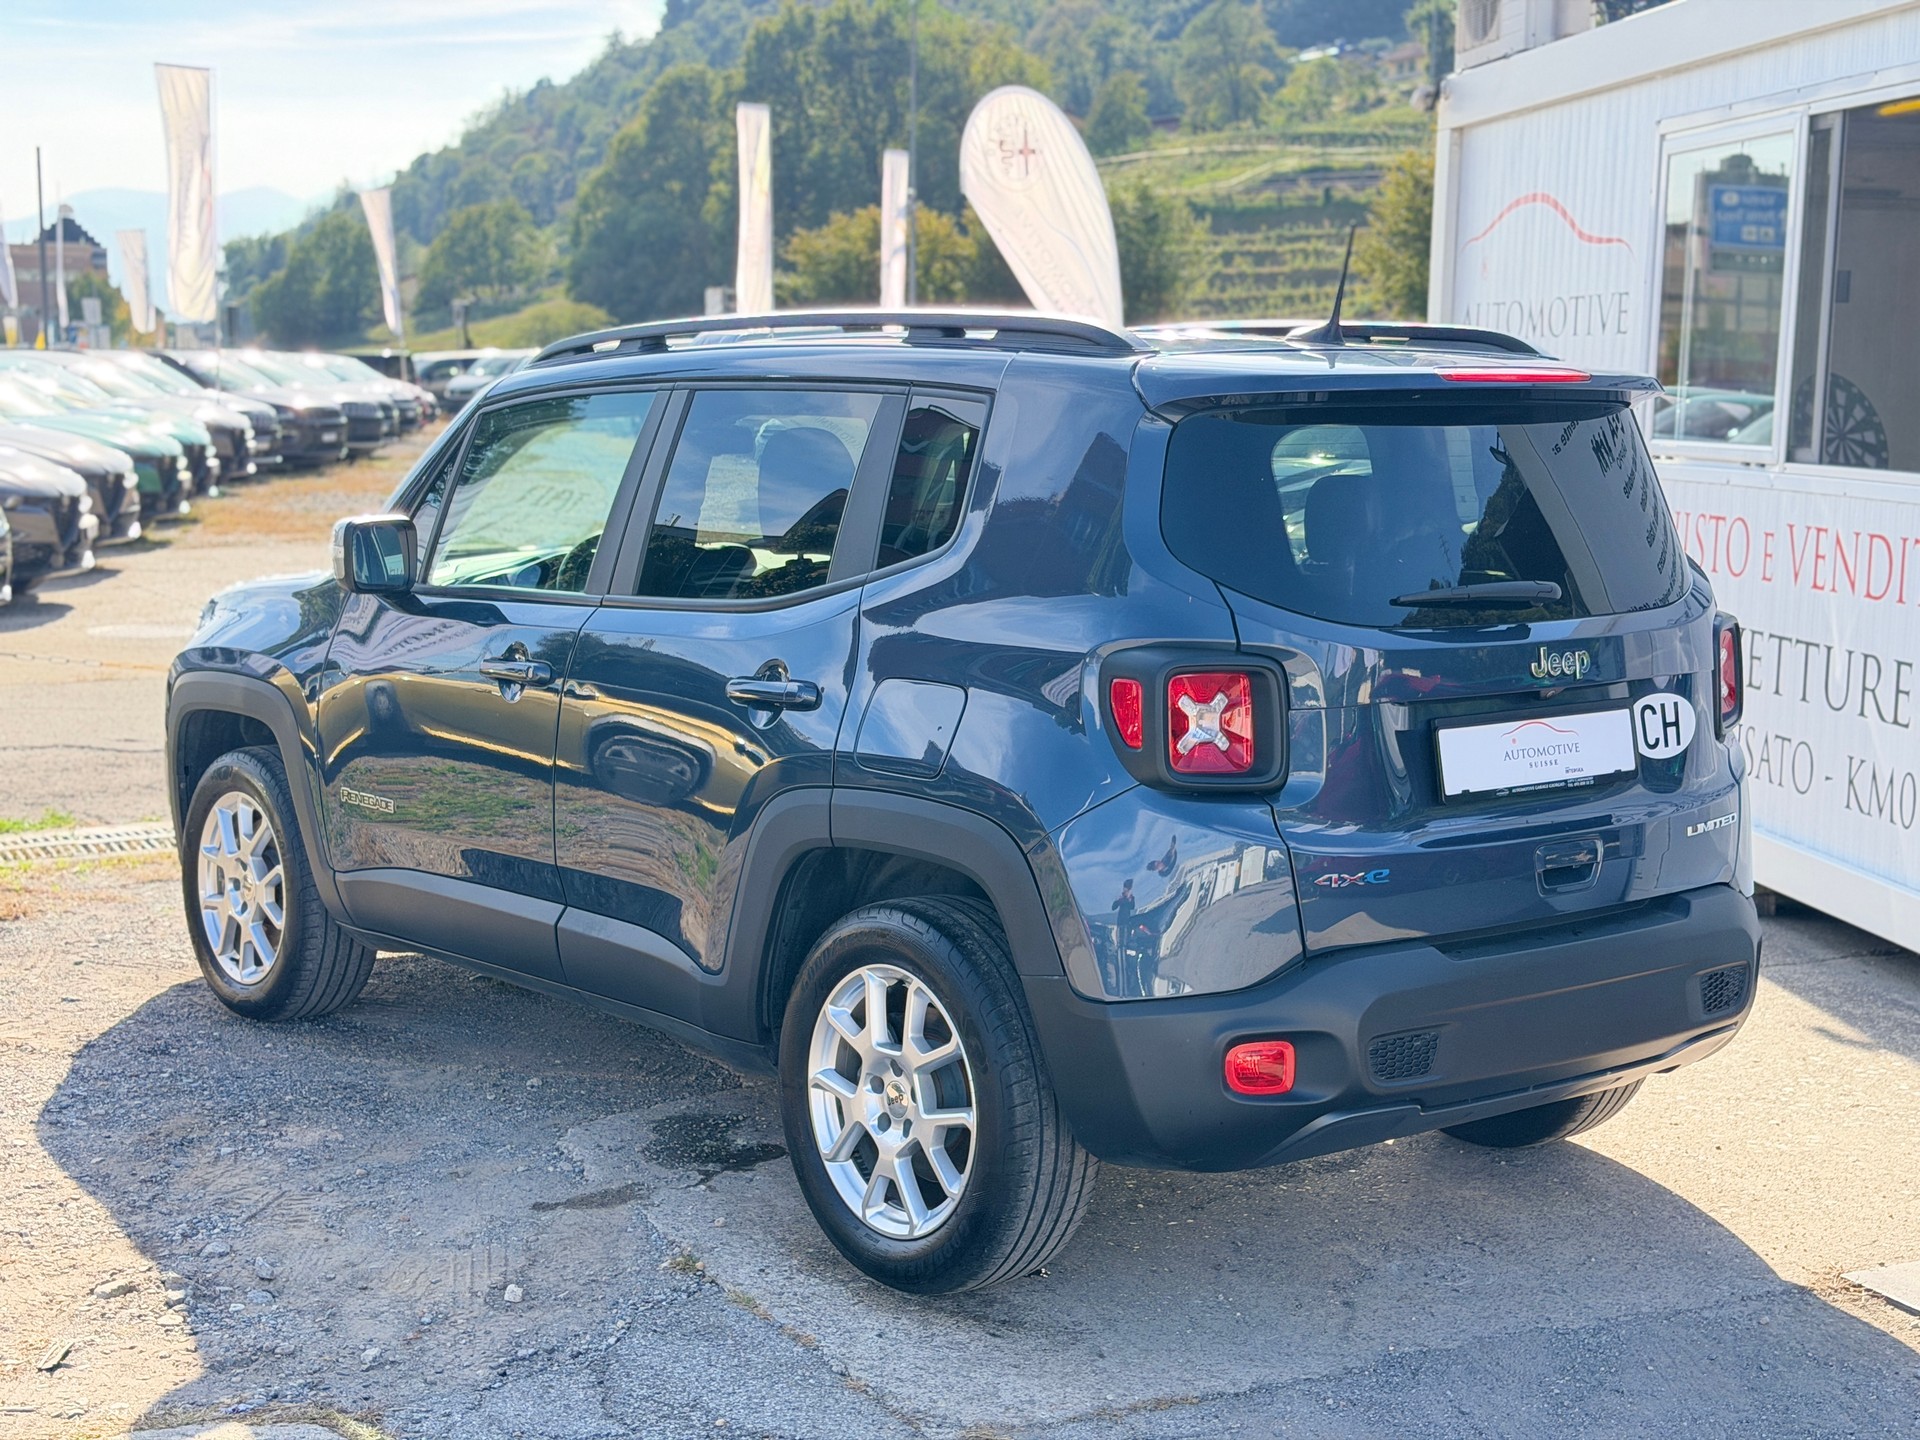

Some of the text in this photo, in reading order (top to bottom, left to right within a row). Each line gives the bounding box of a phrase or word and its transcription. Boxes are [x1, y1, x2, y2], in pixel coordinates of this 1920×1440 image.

[1463, 291, 1630, 339] AUTOMOTIVE
[1761, 531, 1775, 582] E
[1786, 523, 1920, 608] VENDI
[1531, 646, 1591, 680] Jeep
[1740, 627, 1914, 729] ETTURE
[1639, 700, 1681, 750] CH
[1504, 743, 1580, 761] AUTOMOTIVE
[1529, 760, 1558, 768] SUISSE
[1738, 724, 1814, 795] SATO
[340, 786, 396, 814] RENEGADE
[1687, 812, 1737, 837] LIMITED
[887, 1093, 904, 1106] Jeep
